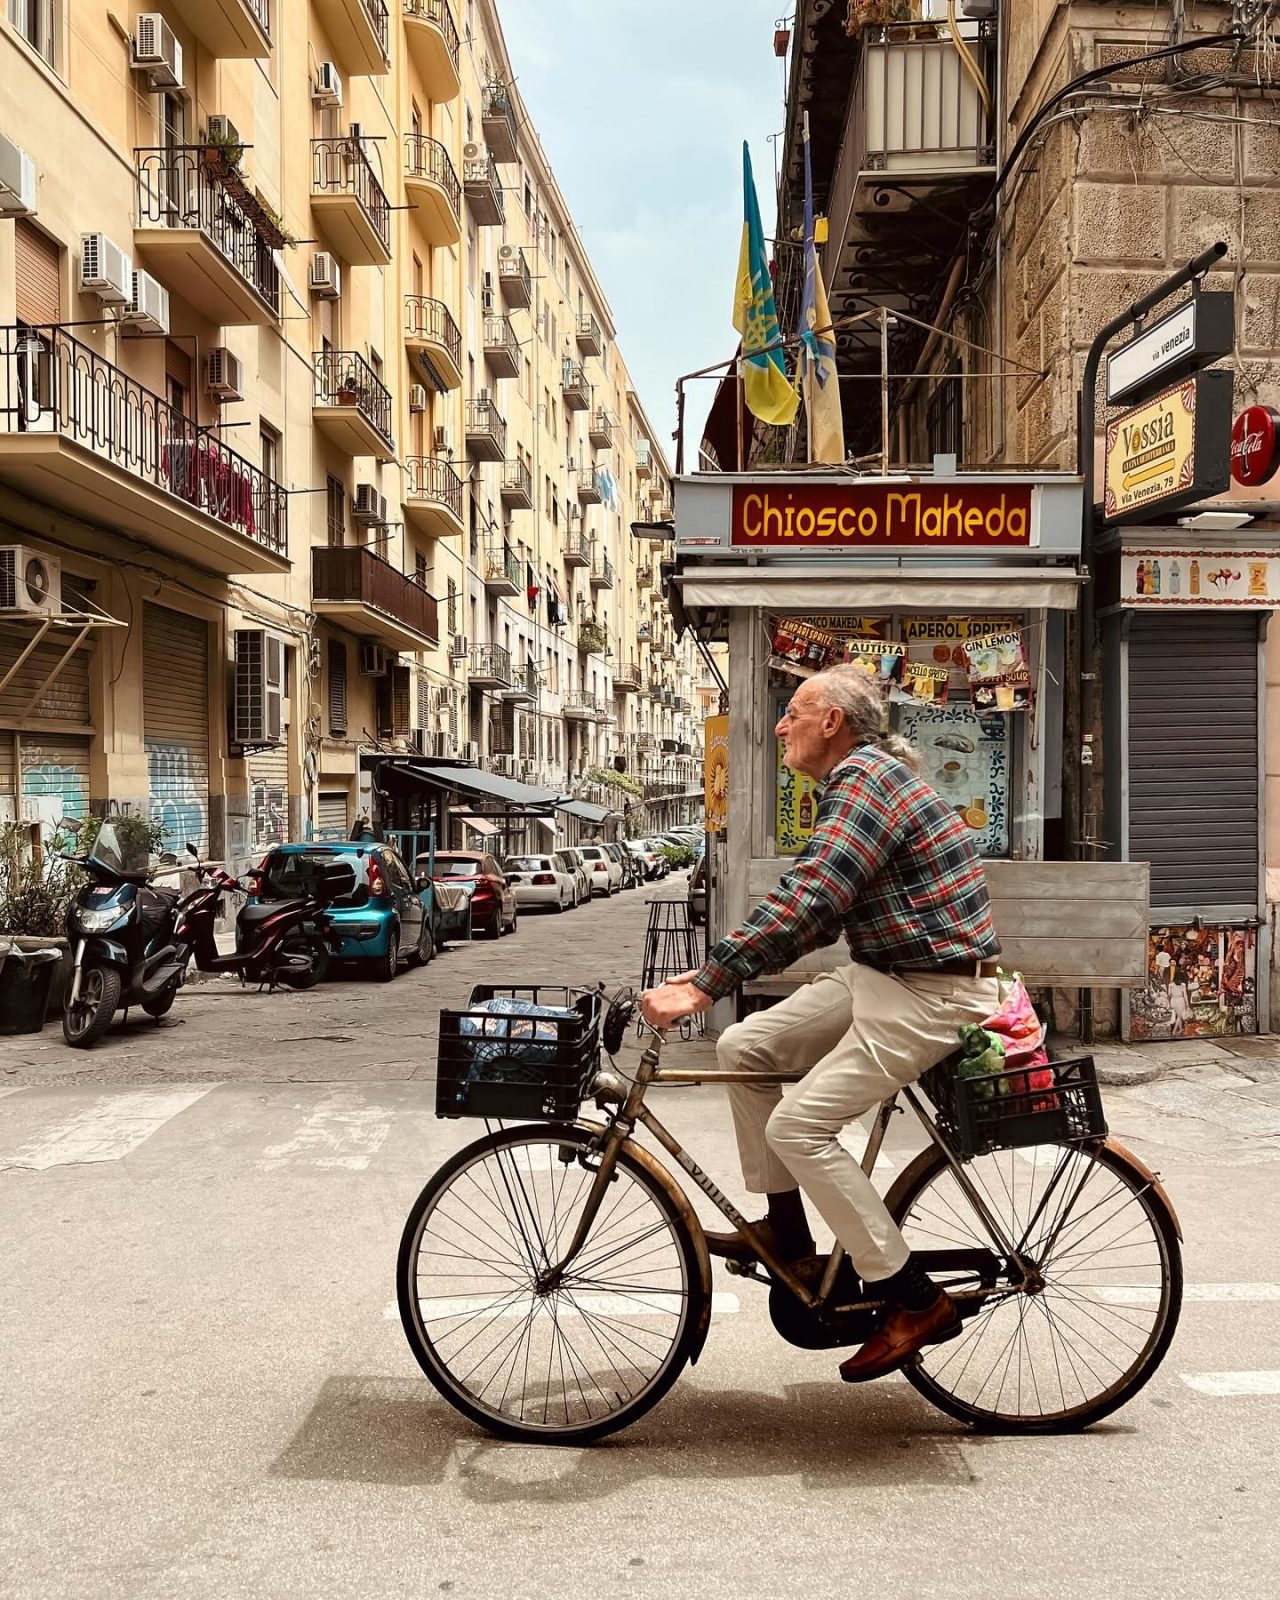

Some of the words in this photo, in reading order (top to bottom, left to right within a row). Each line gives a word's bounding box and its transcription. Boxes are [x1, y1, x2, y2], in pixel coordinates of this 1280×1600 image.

[1161, 326, 1190, 355] venezia
[1121, 493, 1132, 504] Via
[1133, 482, 1163, 500] Venezia,
[1163, 475, 1174, 489] 79
[743, 493, 878, 537] Chiosco
[885, 492, 1027, 537] Makeda
[829, 616, 863, 630] MAKEDA
[908, 622, 963, 638] APEROL
[780, 619, 809, 637] CAMPARI
[808, 630, 832, 646] SPRITZ
[850, 643, 903, 655] AUTISTA
[964, 641, 983, 652] GIN
[985, 632, 1019, 648] LEMON
[928, 668, 947, 680] SPRITZ
[1005, 671, 1029, 682] SOUR
